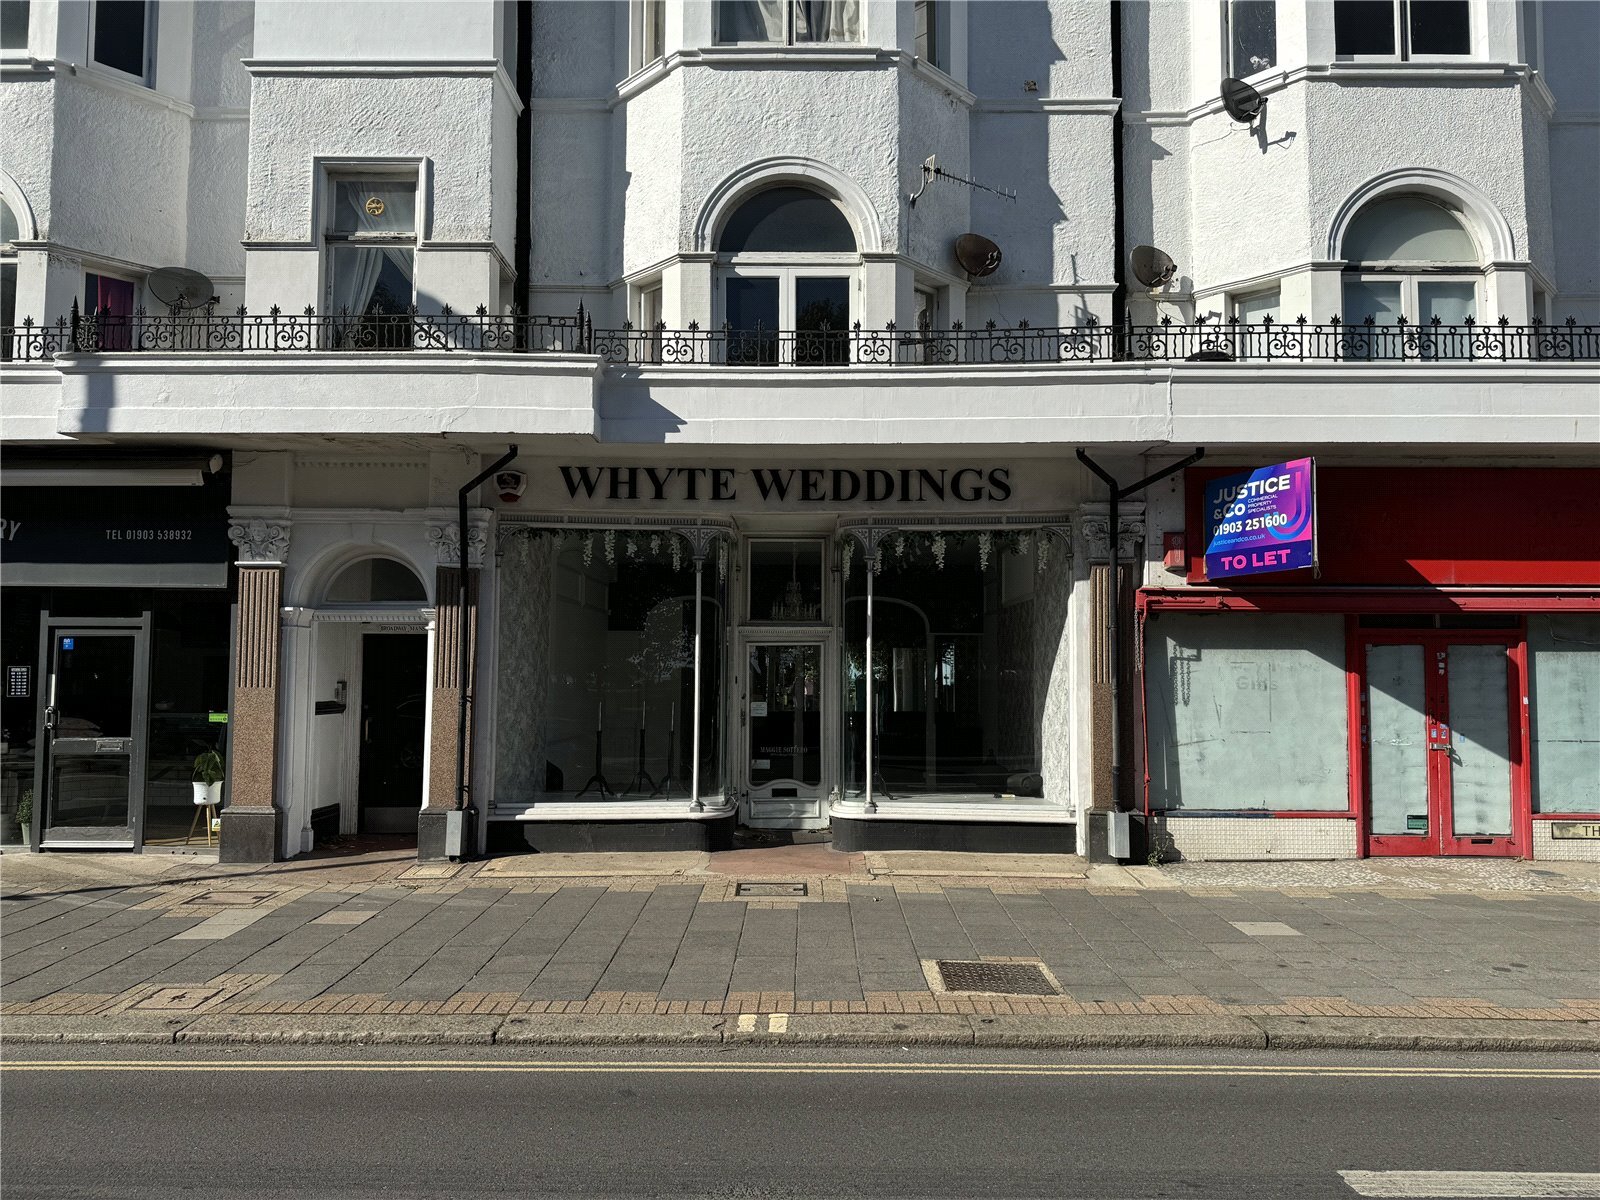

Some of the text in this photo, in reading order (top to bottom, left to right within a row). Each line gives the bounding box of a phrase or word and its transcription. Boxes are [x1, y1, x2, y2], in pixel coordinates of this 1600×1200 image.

[559, 466, 1012, 502] WHYTE WEDDINGS
[1213, 474, 1291, 504] JUSTICE
[1247, 494, 1278, 504] COMMERCIAL
[1247, 500, 1273, 509] PROPERTY
[1247, 505, 1277, 514] SPECIALISTS
[1213, 513, 1288, 537] 01903 251600
[105, 529, 192, 540] TEL 01903 538932
[1212, 534, 1266, 548] justiceandco.co.uk
[1221, 549, 1291, 571] TO LET
